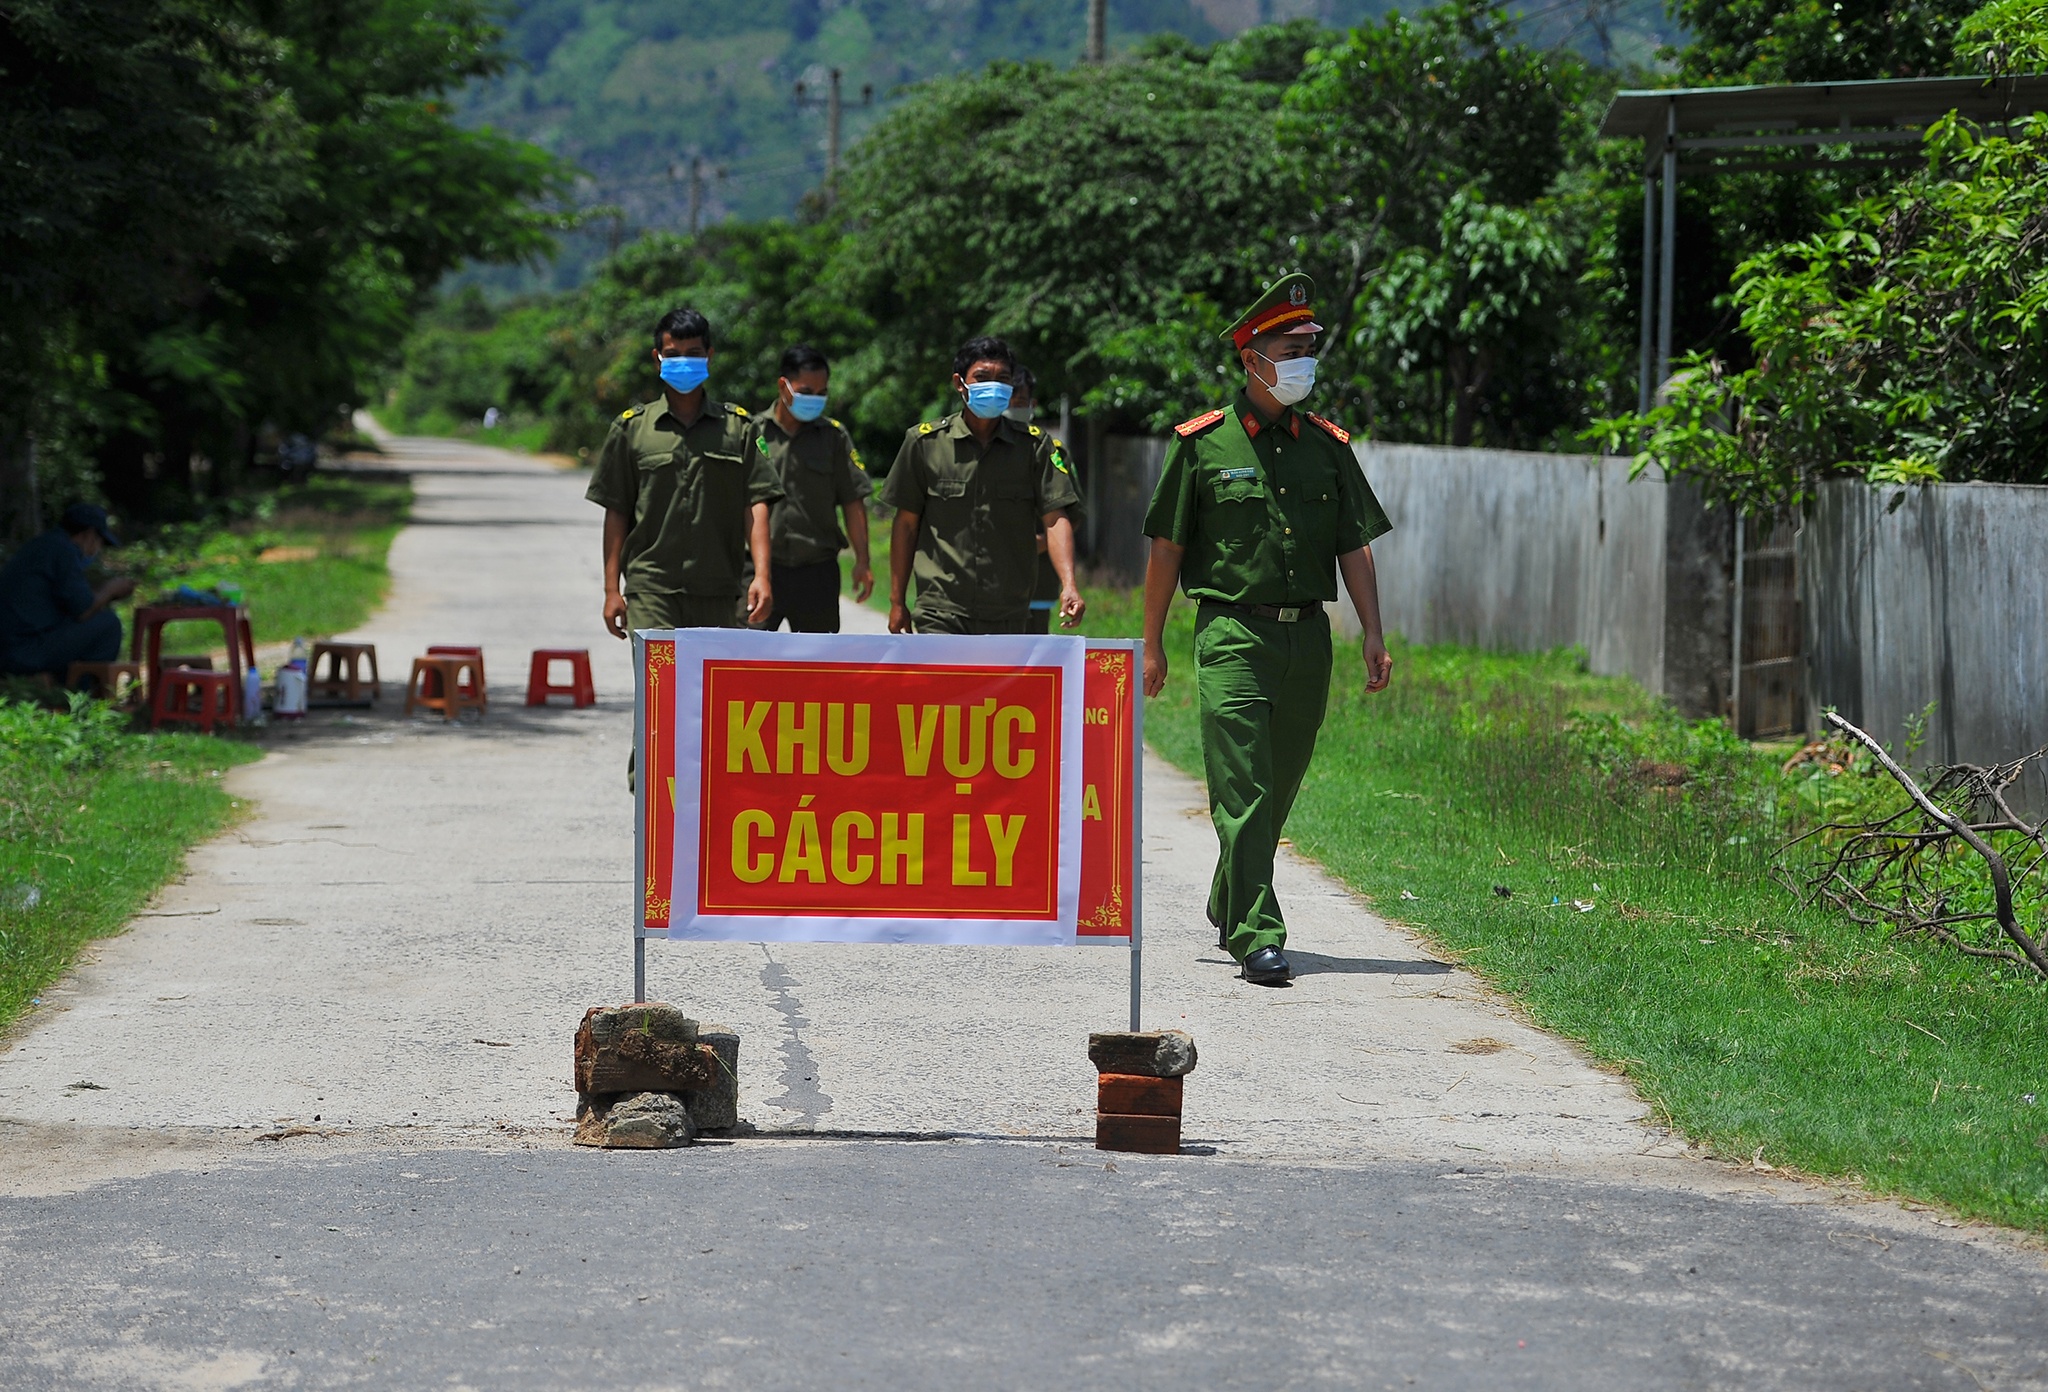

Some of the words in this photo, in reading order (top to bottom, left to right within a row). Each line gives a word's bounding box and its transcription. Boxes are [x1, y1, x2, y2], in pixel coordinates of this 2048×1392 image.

[726, 700, 871, 776] KHU
[897, 697, 1036, 795] VỰC
[1083, 707, 1109, 725] NG
[731, 795, 925, 886] CÁCH
